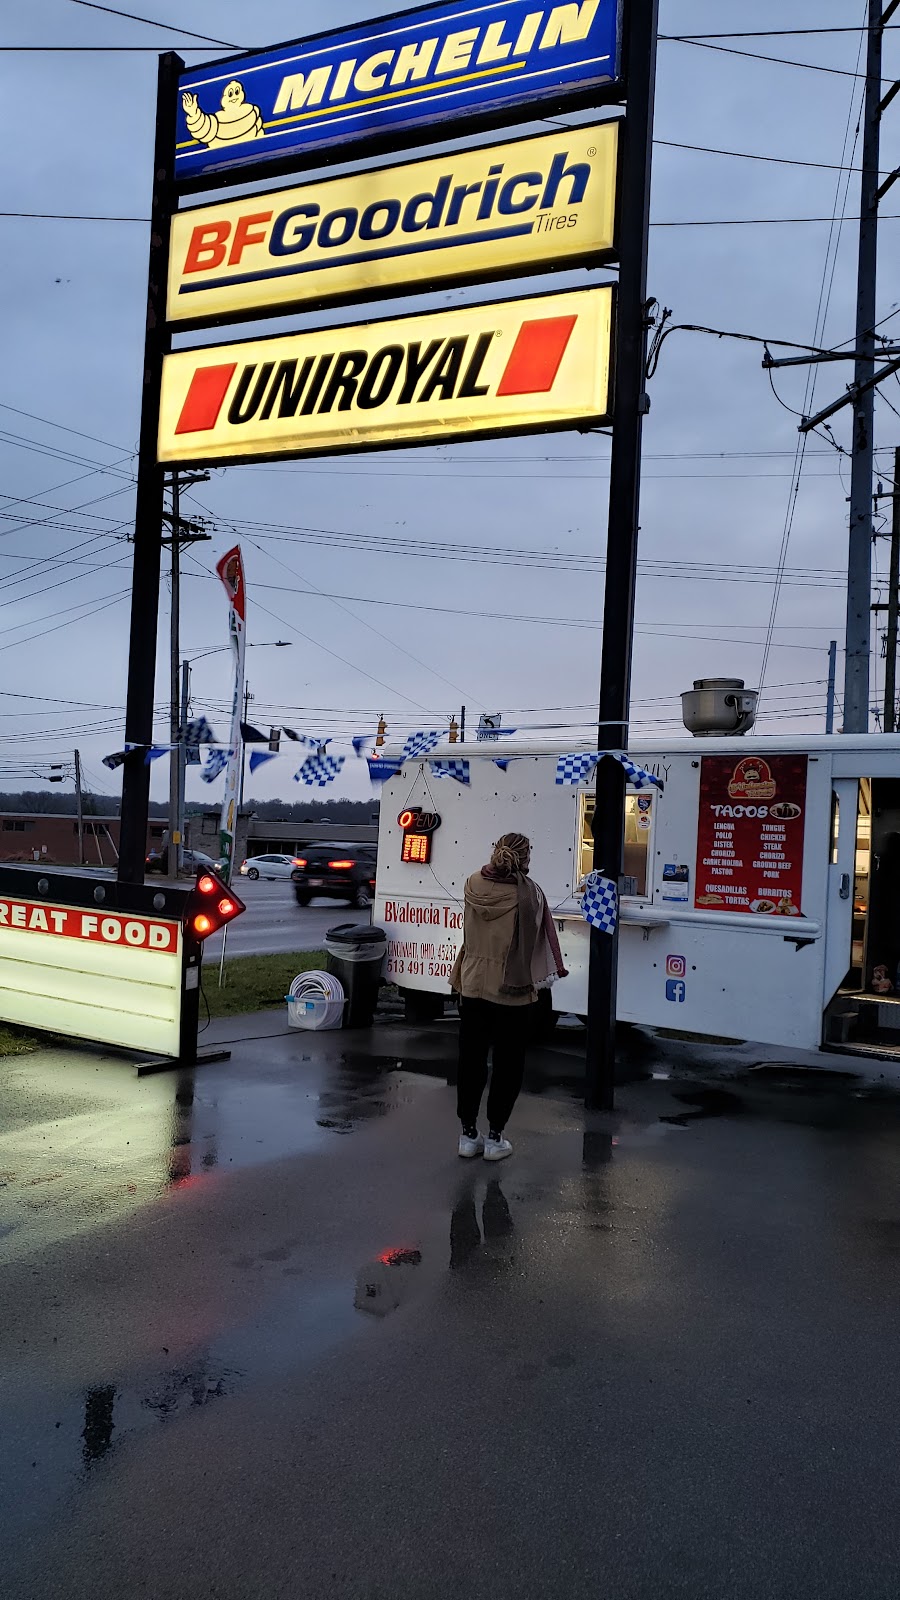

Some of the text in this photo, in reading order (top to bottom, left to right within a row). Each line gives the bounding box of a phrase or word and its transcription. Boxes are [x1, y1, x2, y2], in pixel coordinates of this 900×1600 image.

[272, 0, 601, 113] MICHELIN
[182, 151, 591, 275] BFGoodrich
[535, 212, 578, 235] Tires
[227, 331, 496, 425] UNIROYAL
[710, 804, 769, 819] TACOS
[400, 812, 434, 828] OPEN
[762, 824, 785, 832] TONGUE
[711, 849, 735, 857] CHORIZO
[759, 852, 785, 860] CHORIZO
[703, 858, 743, 867] CARNE MOLIDA
[752, 860, 792, 870] GROUND BEEF
[705, 884, 747, 894] QUESADILLAS
[758, 888, 792, 898] BURRITOS
[725, 896, 750, 905] TORTAS
[384, 901, 440, 925] BValencia
[81, 915, 171, 949] FOOD
[386, 959, 452, 978] 513 491 5203
